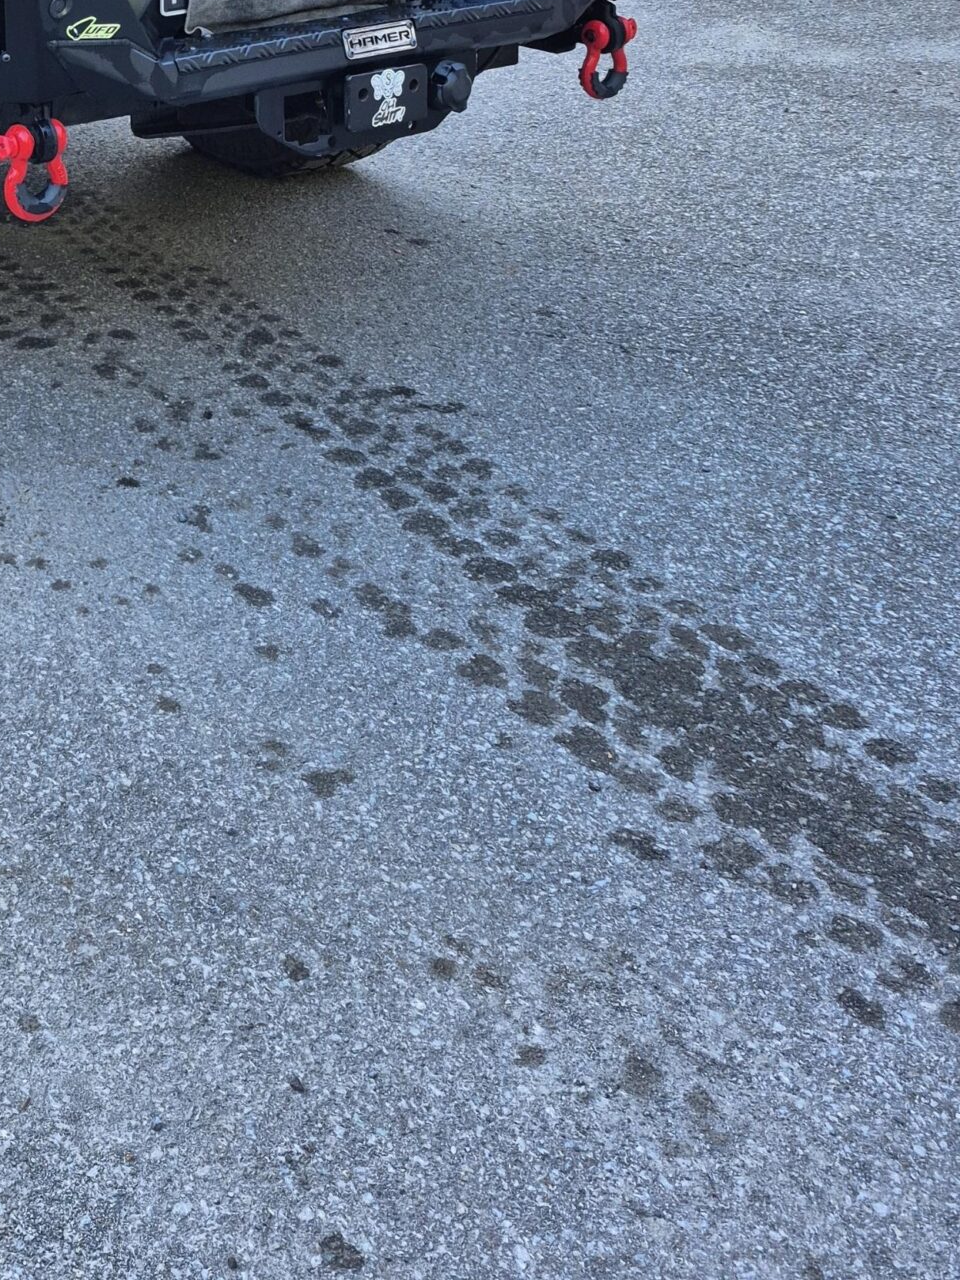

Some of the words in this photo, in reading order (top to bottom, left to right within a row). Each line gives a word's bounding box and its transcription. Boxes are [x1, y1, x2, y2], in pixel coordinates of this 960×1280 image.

[85, 26, 118, 34] UFO
[349, 30, 410, 49] HAMER
[373, 107, 405, 126] SHIT!
